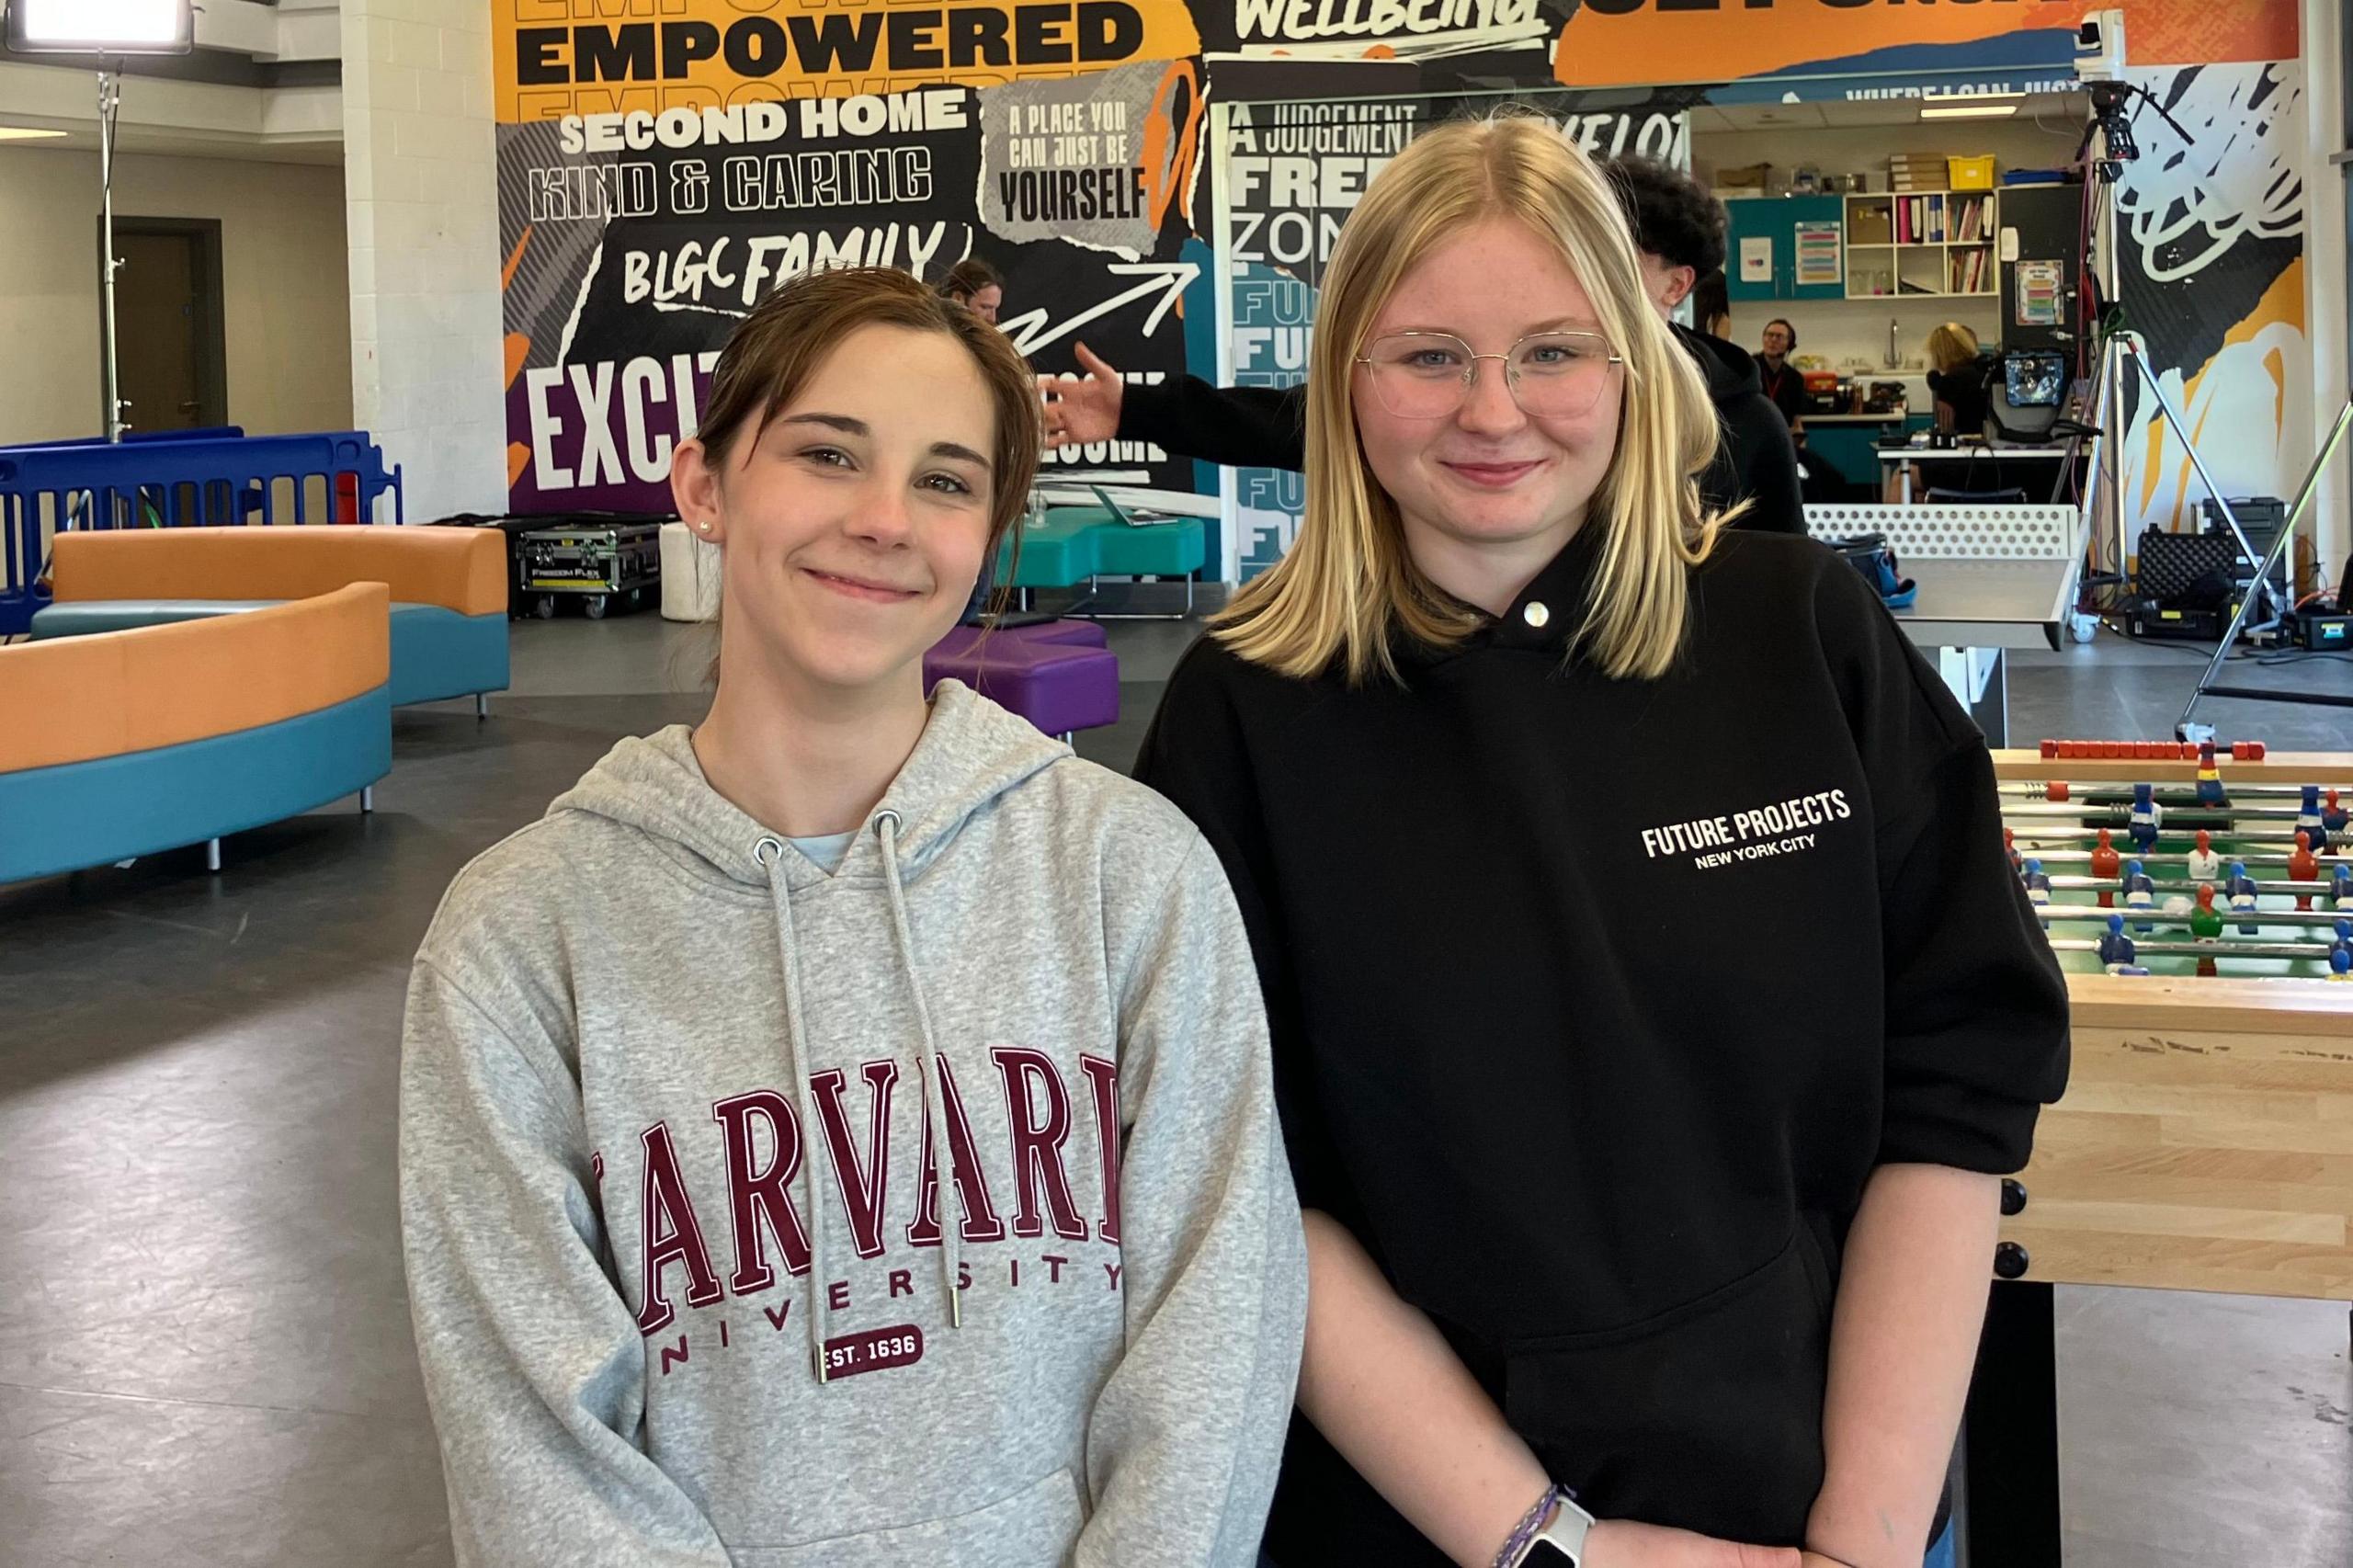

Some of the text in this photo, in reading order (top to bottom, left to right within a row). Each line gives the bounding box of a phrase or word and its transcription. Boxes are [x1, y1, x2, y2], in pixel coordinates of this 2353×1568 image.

[517, 2, 1143, 85] EMPOWERED
[560, 88, 967, 153] SECOND HOME
[1009, 101, 1126, 135] A PLACE YOU
[1231, 104, 1417, 153] A JUDGEMENT
[1009, 135, 1128, 168] CAN JUST BE
[529, 145, 933, 222] KIND & CARING
[999, 167, 1146, 222] YOURSELF
[625, 236, 736, 304] BLGC
[1233, 326, 1313, 369] FU
[1641, 789, 1851, 858] FUTURE PROJECTS
[1695, 834, 1816, 869] NEW YORK CITY
[592, 1047, 1120, 1338] ARVAR
[868, 1335, 916, 1359] 1636
